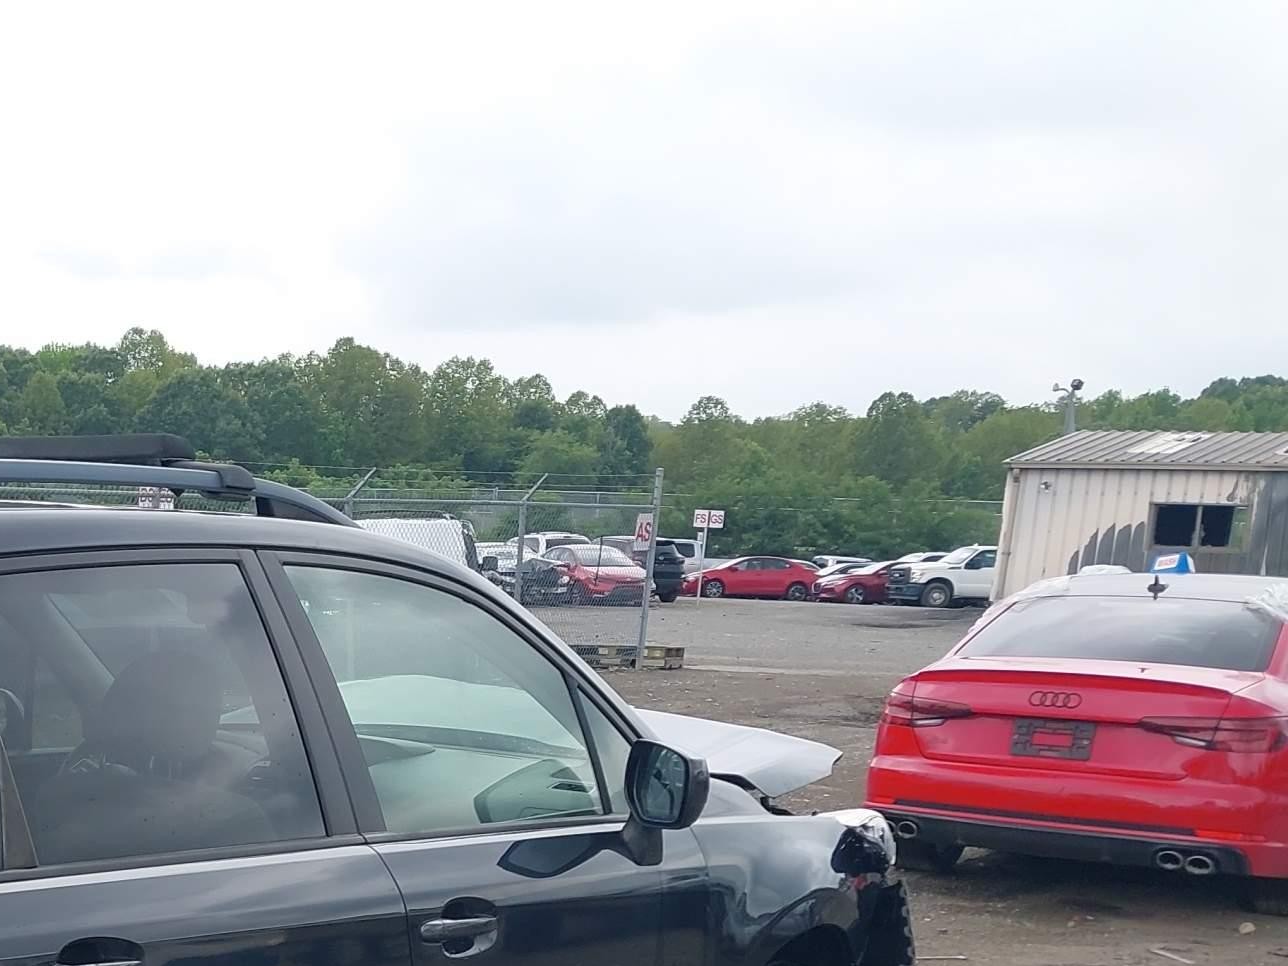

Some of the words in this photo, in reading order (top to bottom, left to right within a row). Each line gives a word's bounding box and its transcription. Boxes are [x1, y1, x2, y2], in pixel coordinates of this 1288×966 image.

[695, 513, 707, 524] FS
[711, 514, 724, 524] GS
[636, 522, 652, 542] AS
